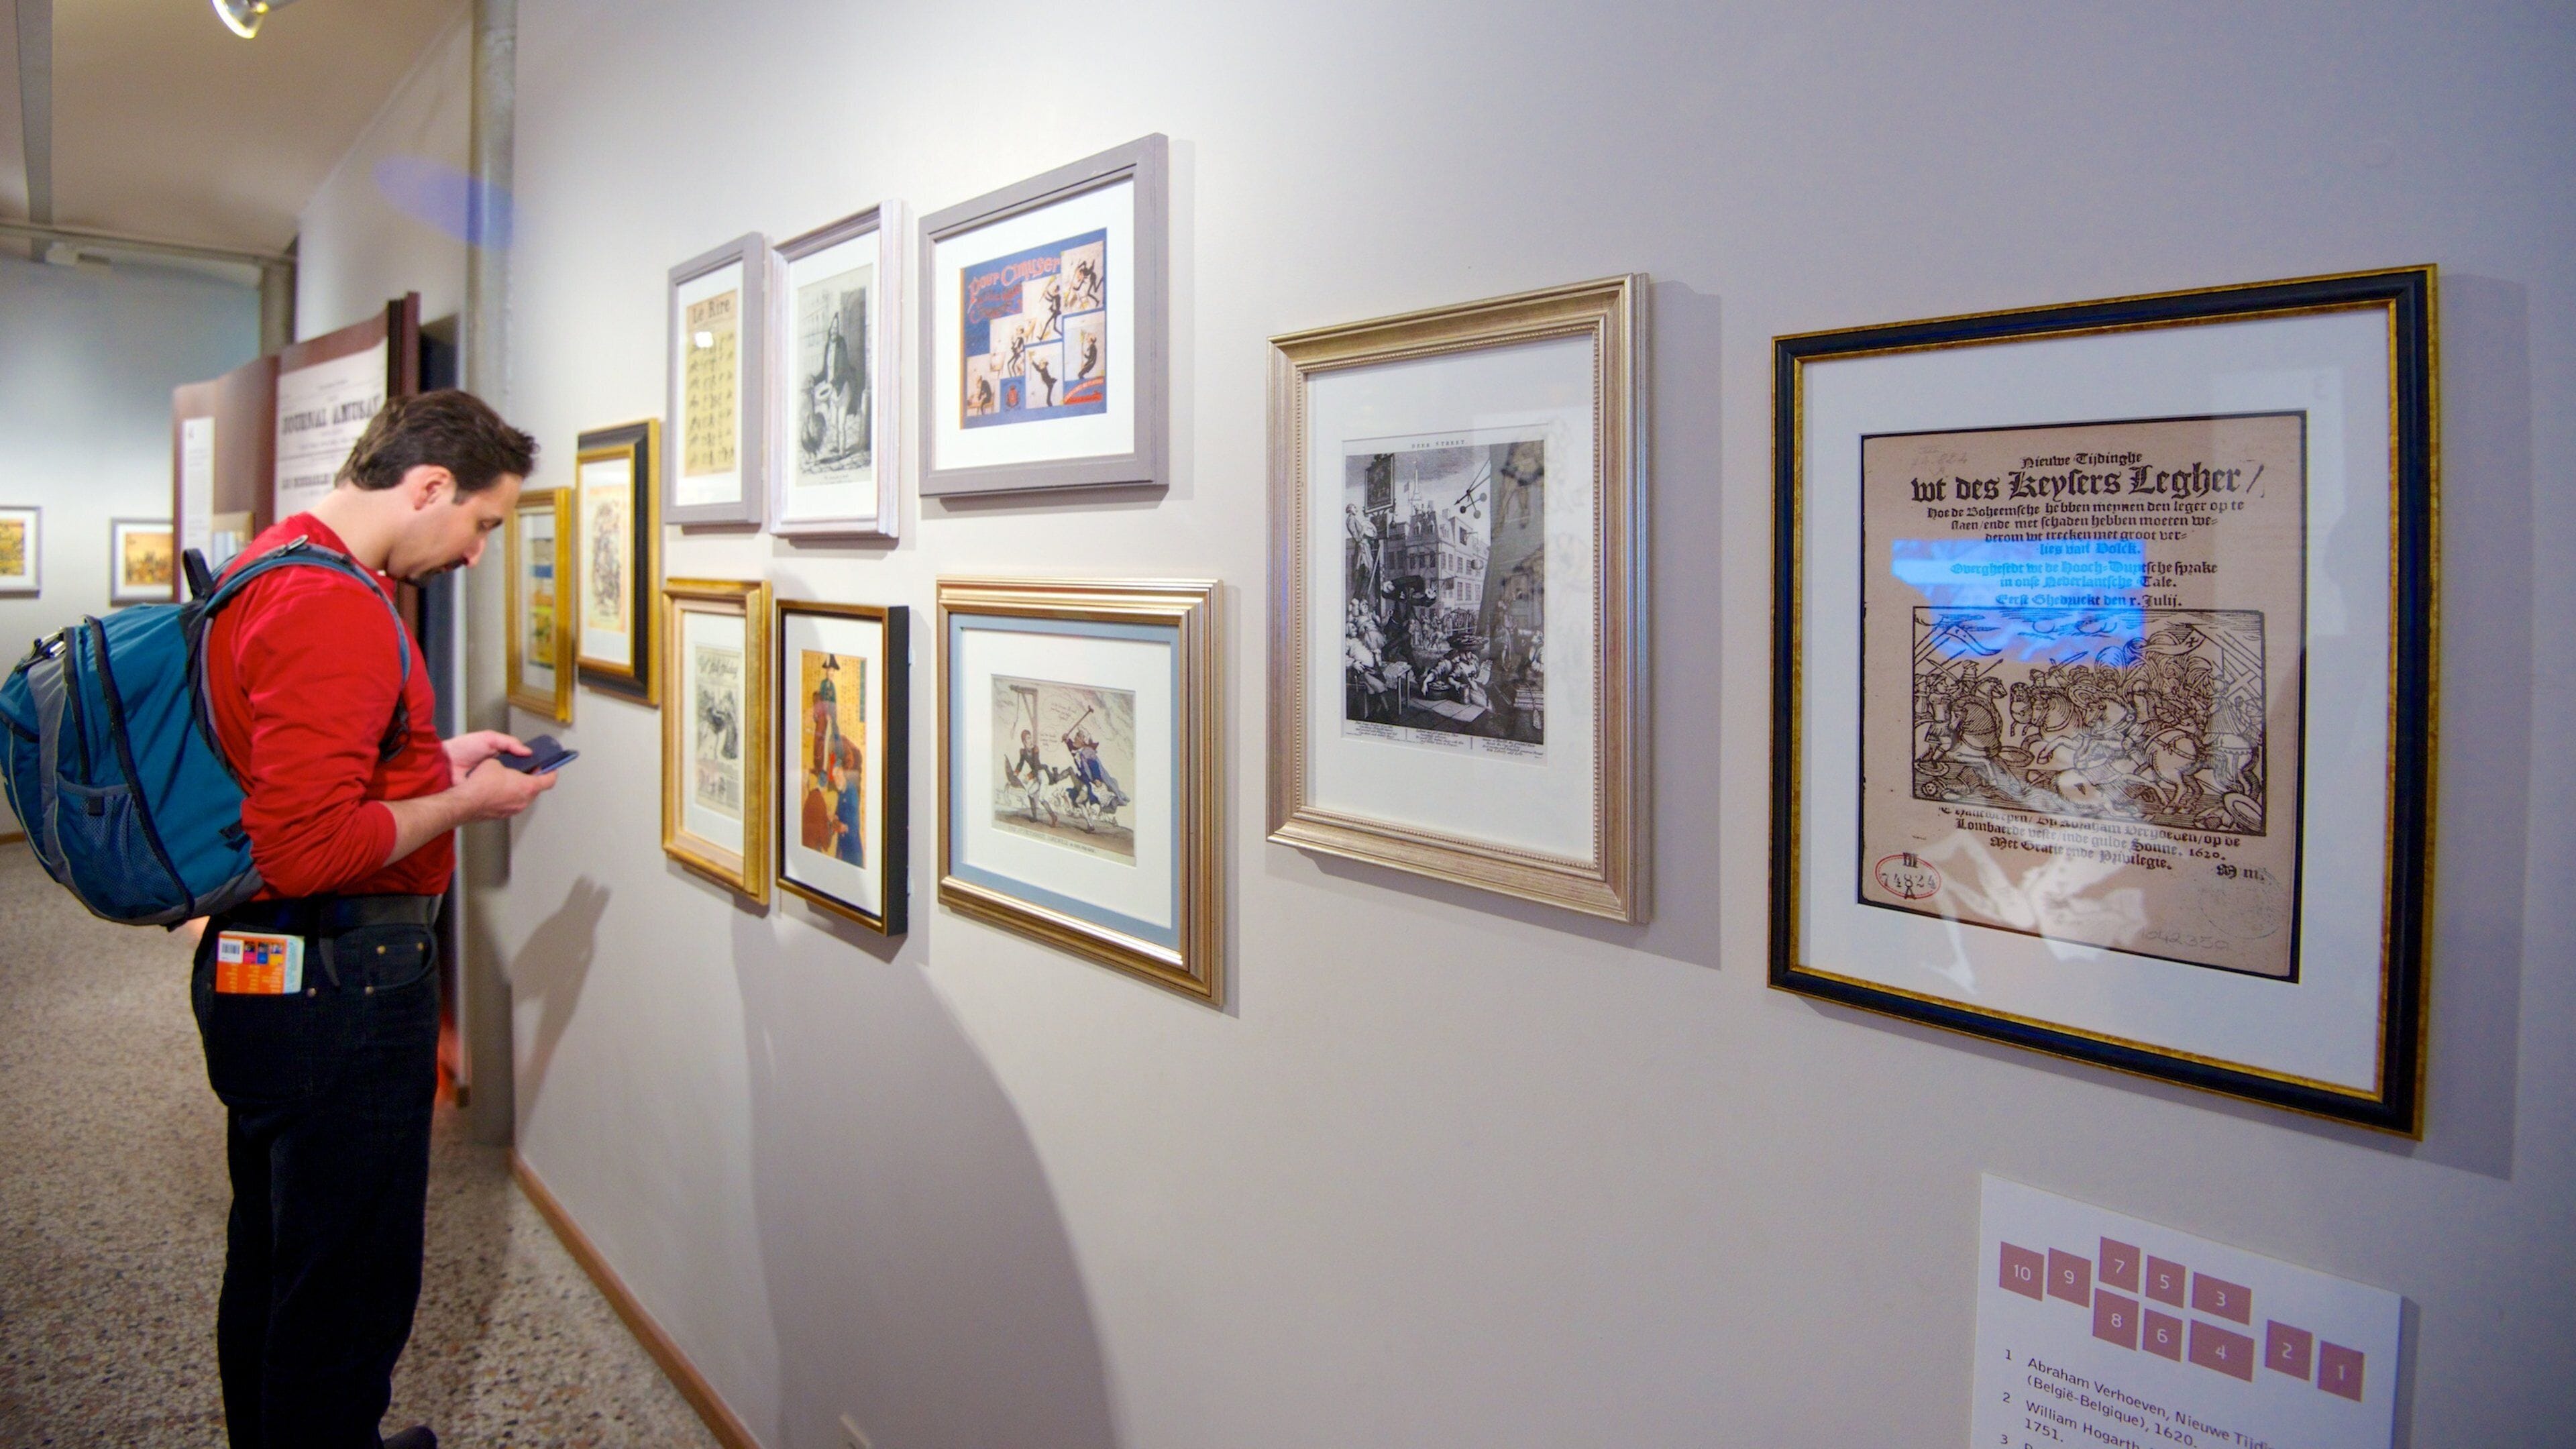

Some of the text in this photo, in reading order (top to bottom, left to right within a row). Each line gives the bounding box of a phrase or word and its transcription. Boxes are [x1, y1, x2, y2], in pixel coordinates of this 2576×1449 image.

[2020, 452, 2143, 470] Nieuwe Tijdinghe
[1955, 476, 2000, 500] des
[1880, 873, 1937, 890] 74824
[2013, 1258, 2226, 1307] 10 9 7 5 3
[2110, 1313, 2345, 1381] 8 6 4 2 1
[2005, 1348, 2012, 1360] 1
[2027, 1358, 2090, 1389] Abraham
[2094, 1381, 2169, 1421] Verhoeven,
[2175, 1411, 2230, 1441] Nieuwe
[2002, 1392, 2010, 1403] 2
[2025, 1399, 2078, 1430] William
[2027, 1375, 2198, 1449] (België-Belgique), 1620.
[2001, 1434, 2008, 1445] 3
[2025, 1417, 2063, 1442] 1751.
